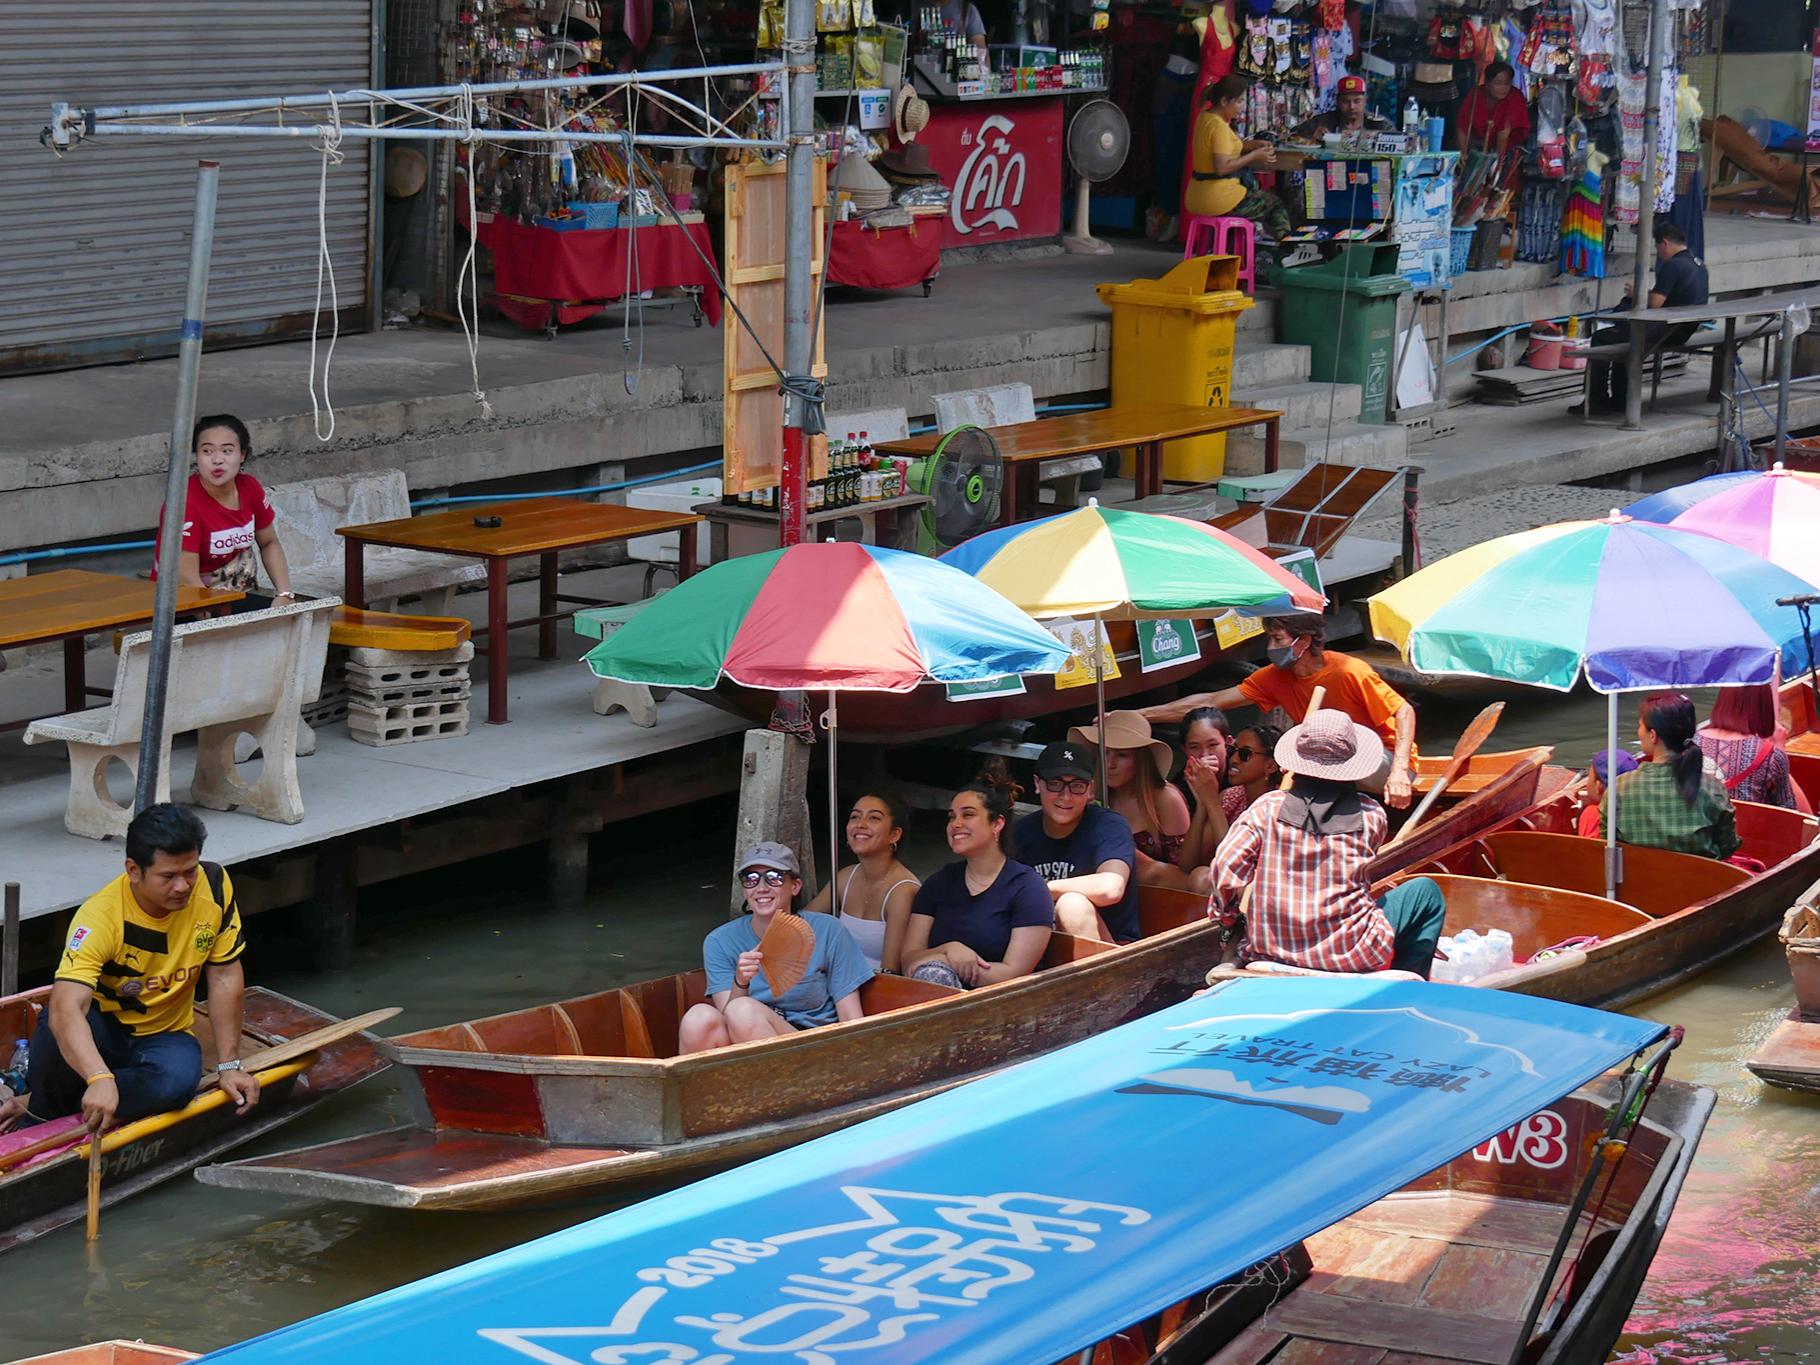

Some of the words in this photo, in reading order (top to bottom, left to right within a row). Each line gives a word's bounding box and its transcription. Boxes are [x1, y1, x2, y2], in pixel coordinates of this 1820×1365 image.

[1376, 143, 1396, 152] 150
[1152, 636, 1180, 653] Chang
[1322, 1046, 1395, 1061] CAT
[636, 1237, 780, 1289] 2018
